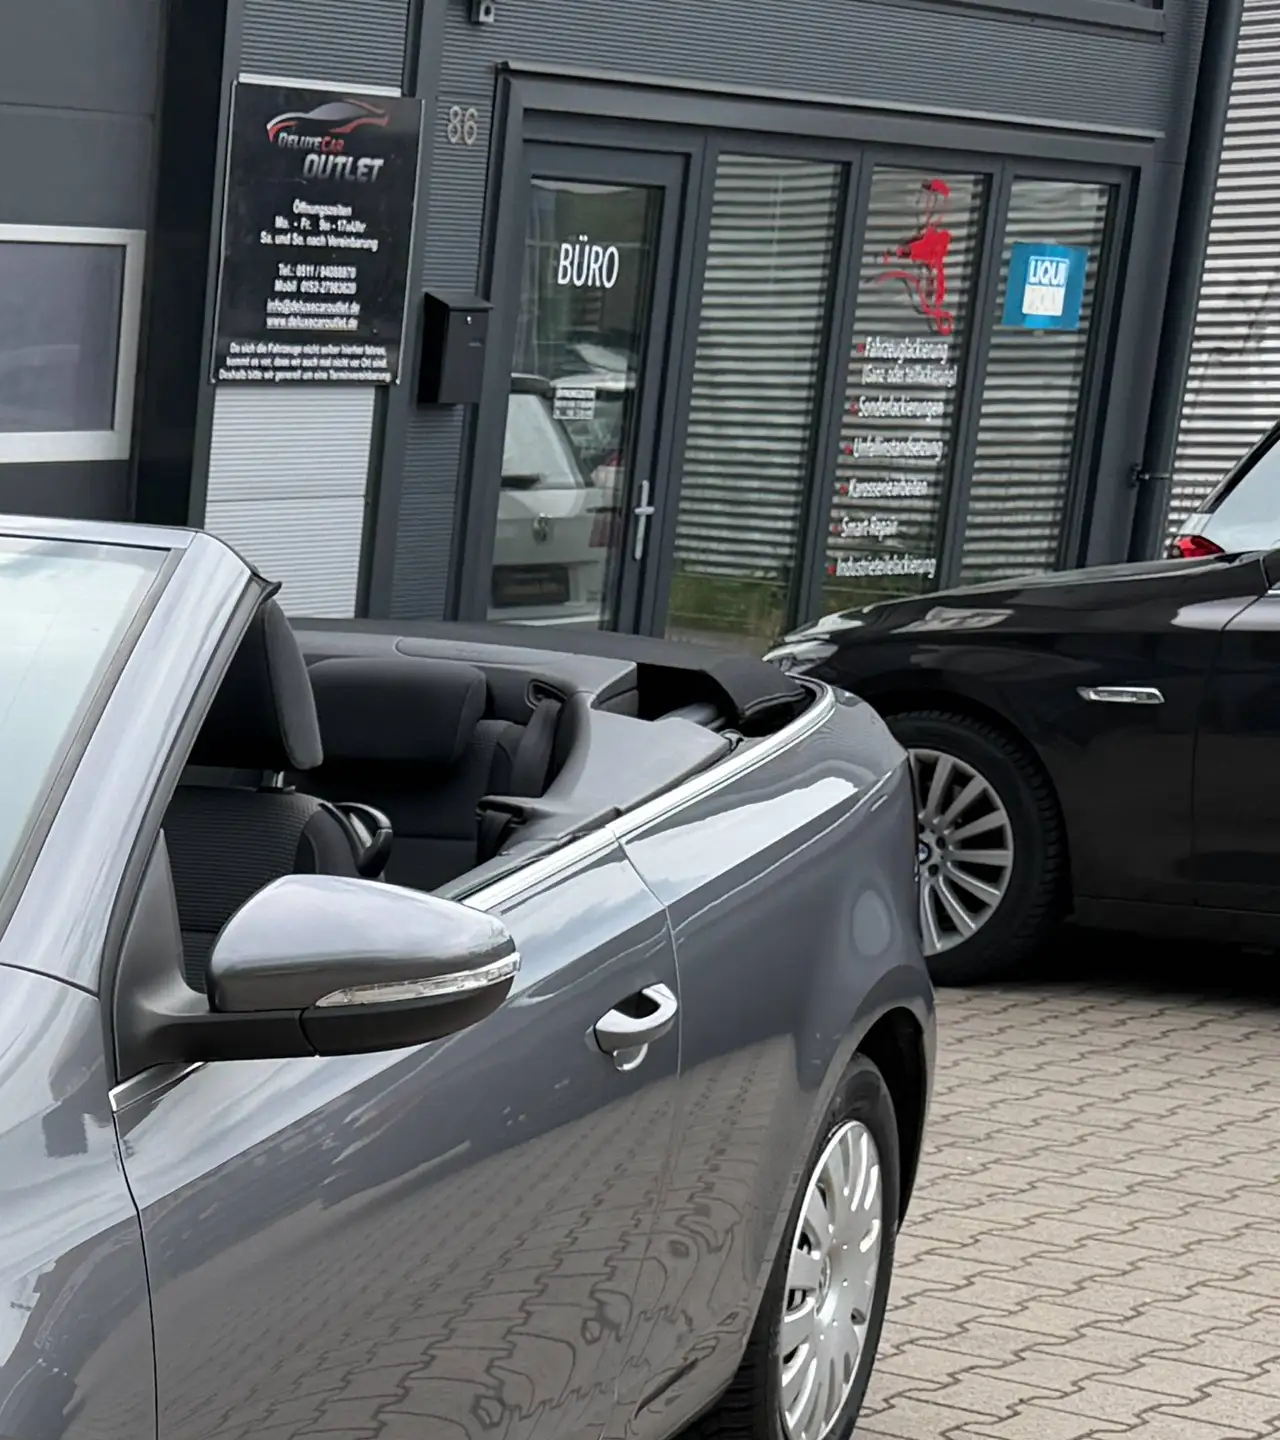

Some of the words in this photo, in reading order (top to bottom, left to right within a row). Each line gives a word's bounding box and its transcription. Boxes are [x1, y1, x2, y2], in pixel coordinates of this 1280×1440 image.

[447, 105, 478, 144] 86
[303, 153, 384, 182] OUTLET
[275, 232, 290, 244] und
[306, 234, 326, 246] nach
[328, 235, 378, 252] Vereinbarung
[558, 234, 619, 288] BÜRO
[1029, 259, 1067, 286] LIQUI
[864, 336, 948, 364] Fahrzeuglackierung
[858, 394, 944, 422] Sonderlackierungen
